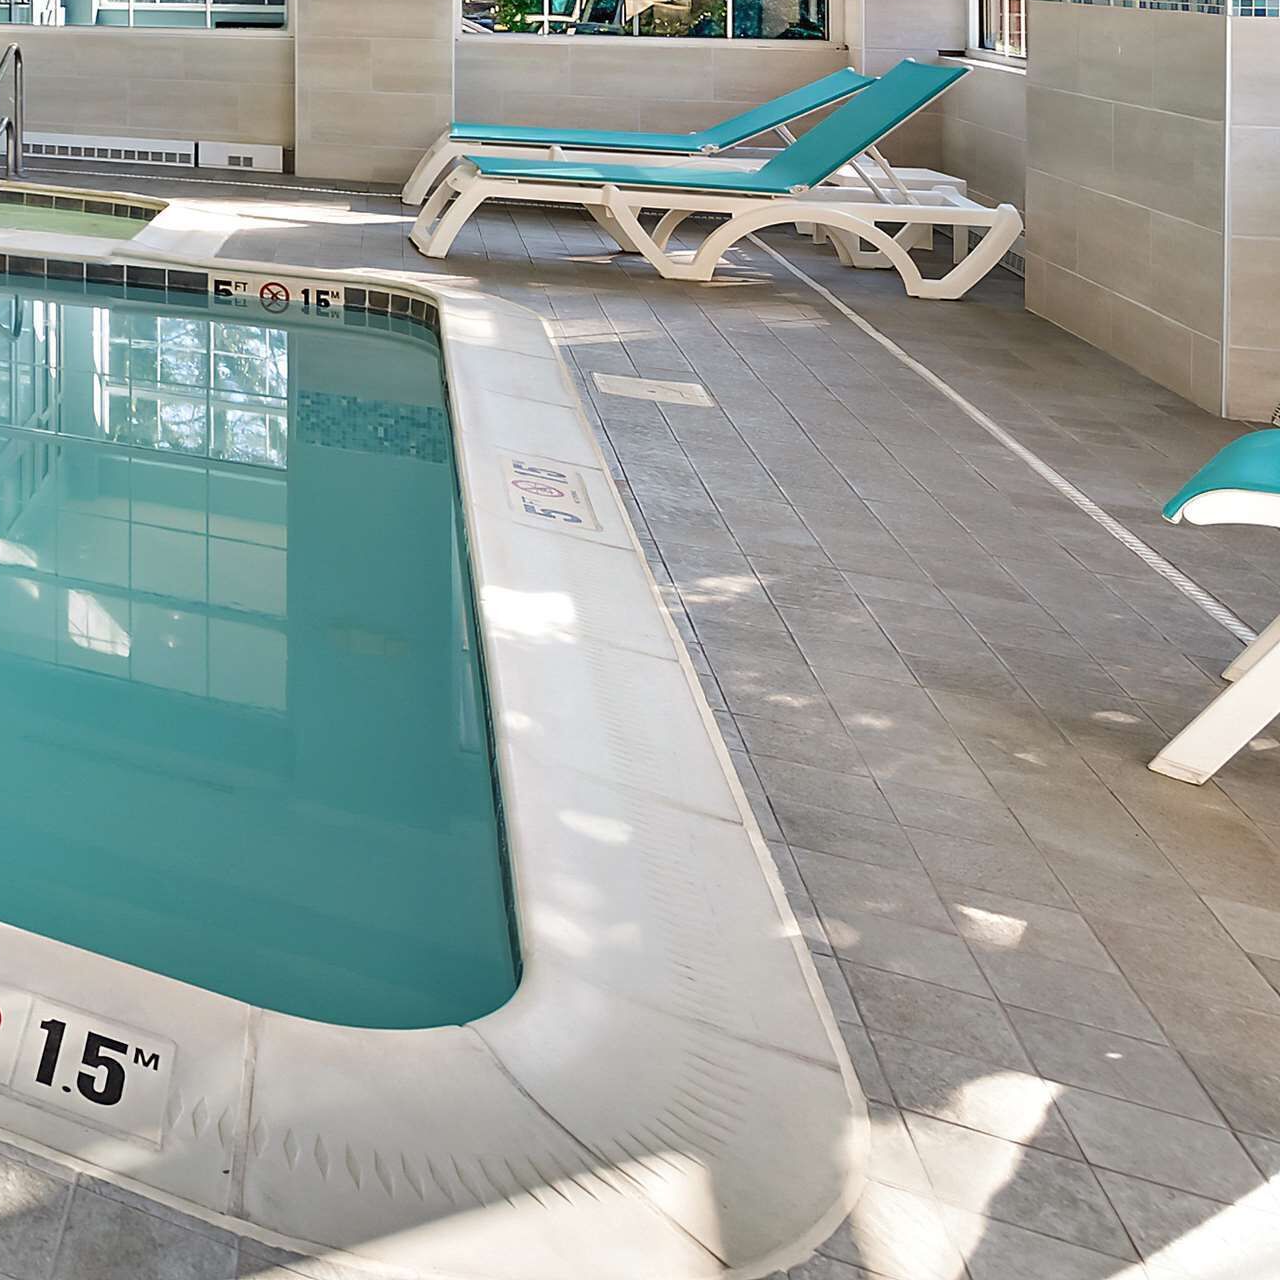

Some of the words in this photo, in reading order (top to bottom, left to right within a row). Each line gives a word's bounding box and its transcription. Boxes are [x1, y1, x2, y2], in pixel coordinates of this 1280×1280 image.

[234, 281, 248, 292] FT
[36, 1018, 129, 1106] 1.5
[133, 1047, 161, 1071] M
